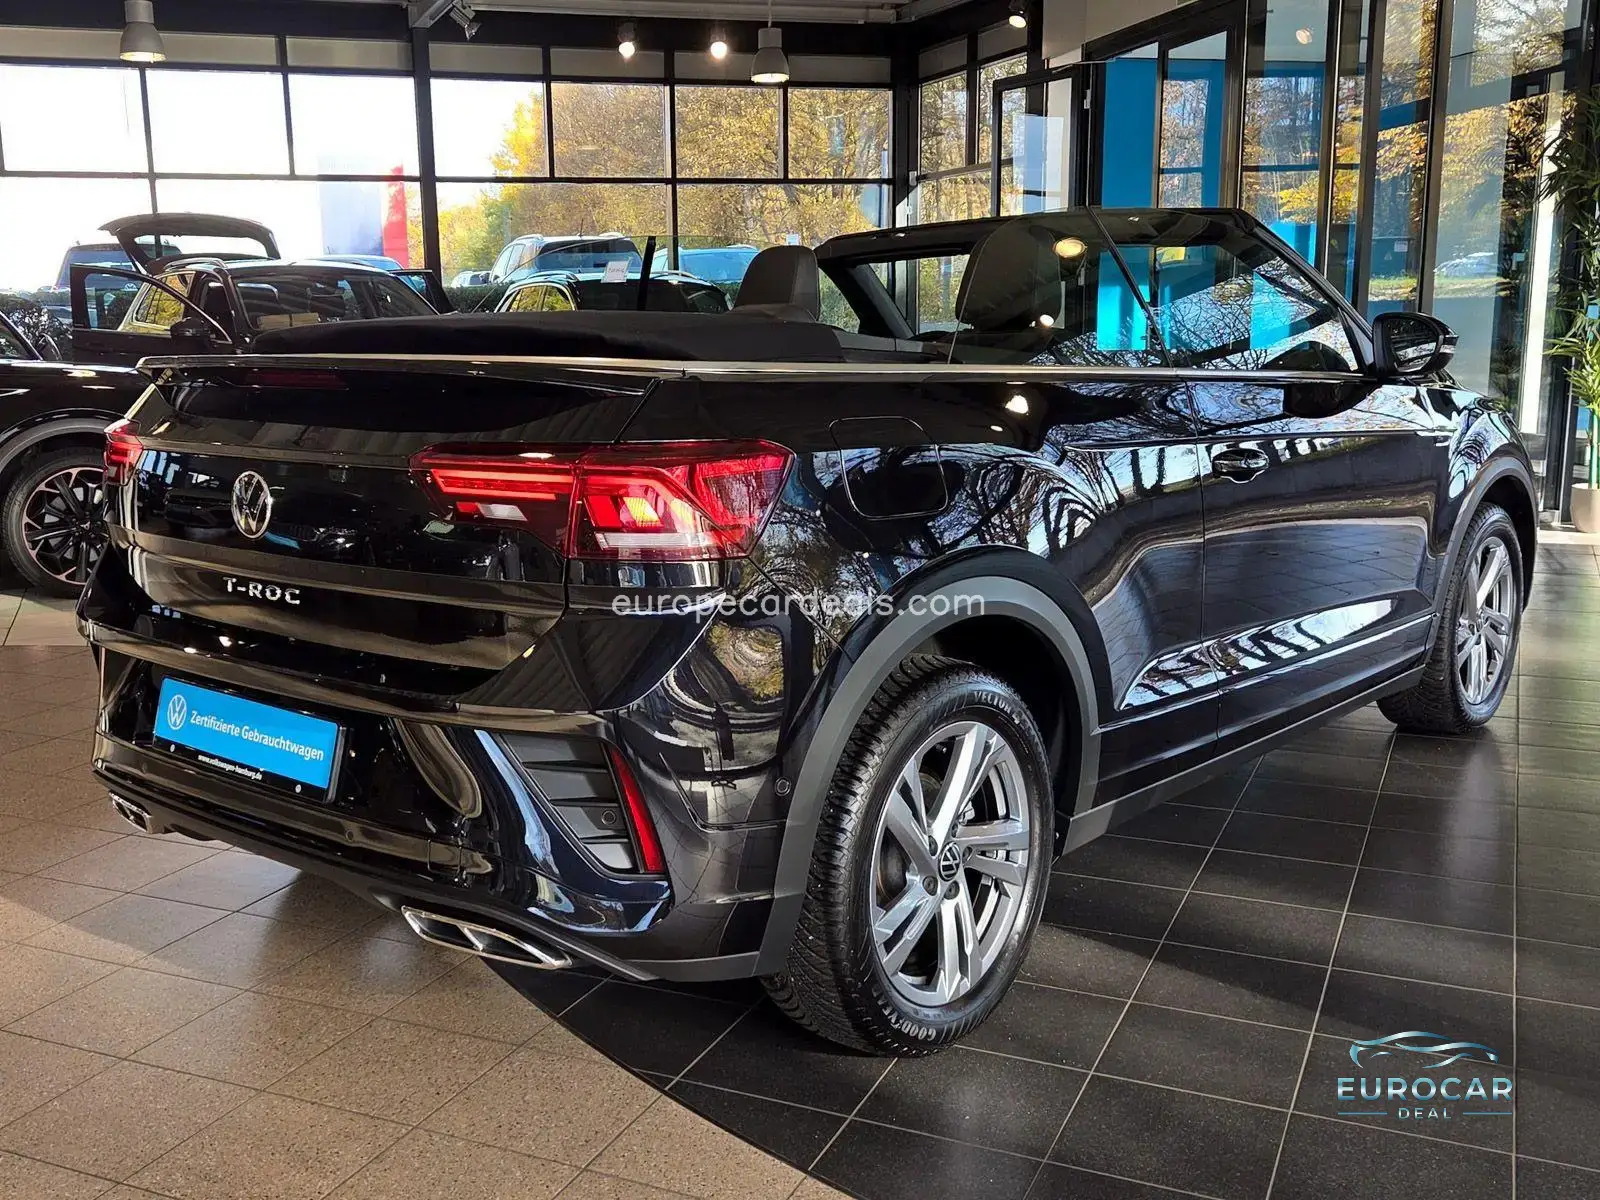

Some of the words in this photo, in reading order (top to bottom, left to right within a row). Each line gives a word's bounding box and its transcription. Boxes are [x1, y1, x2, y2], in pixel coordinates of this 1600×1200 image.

[223, 577, 300, 605] T-ROC
[190, 710, 240, 738] Zertifizierte
[241, 725, 324, 762] Gebrauchtwagen
